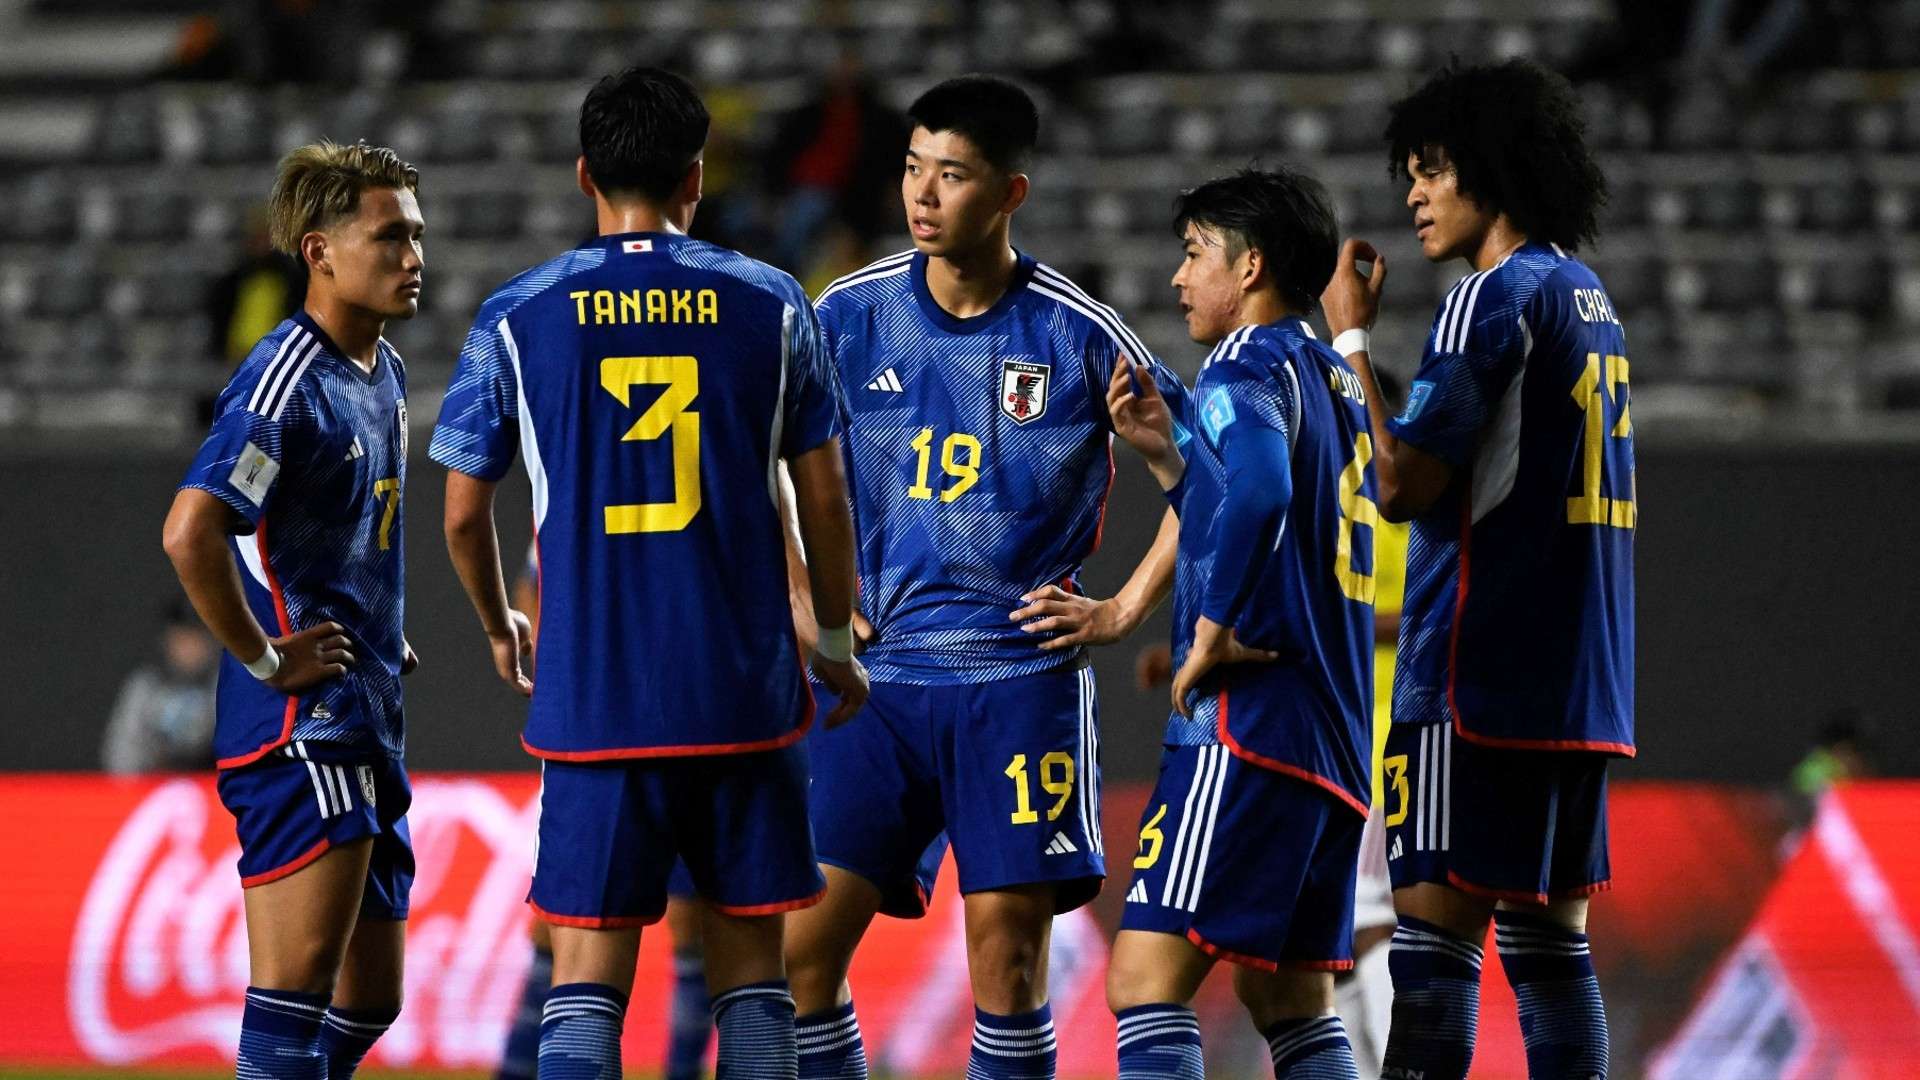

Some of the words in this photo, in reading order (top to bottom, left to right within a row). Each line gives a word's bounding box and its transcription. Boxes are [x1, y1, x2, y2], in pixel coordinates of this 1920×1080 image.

[570, 289, 718, 324] TANAKA
[1014, 364, 1039, 373] JAPAN
[600, 356, 701, 534] 3
[1011, 403, 1032, 415] JFA
[908, 428, 982, 503] 19
[374, 477, 400, 551] 7
[1335, 432, 1378, 605] 6
[1004, 751, 1075, 824] 19
[1133, 804, 1165, 869] 6
